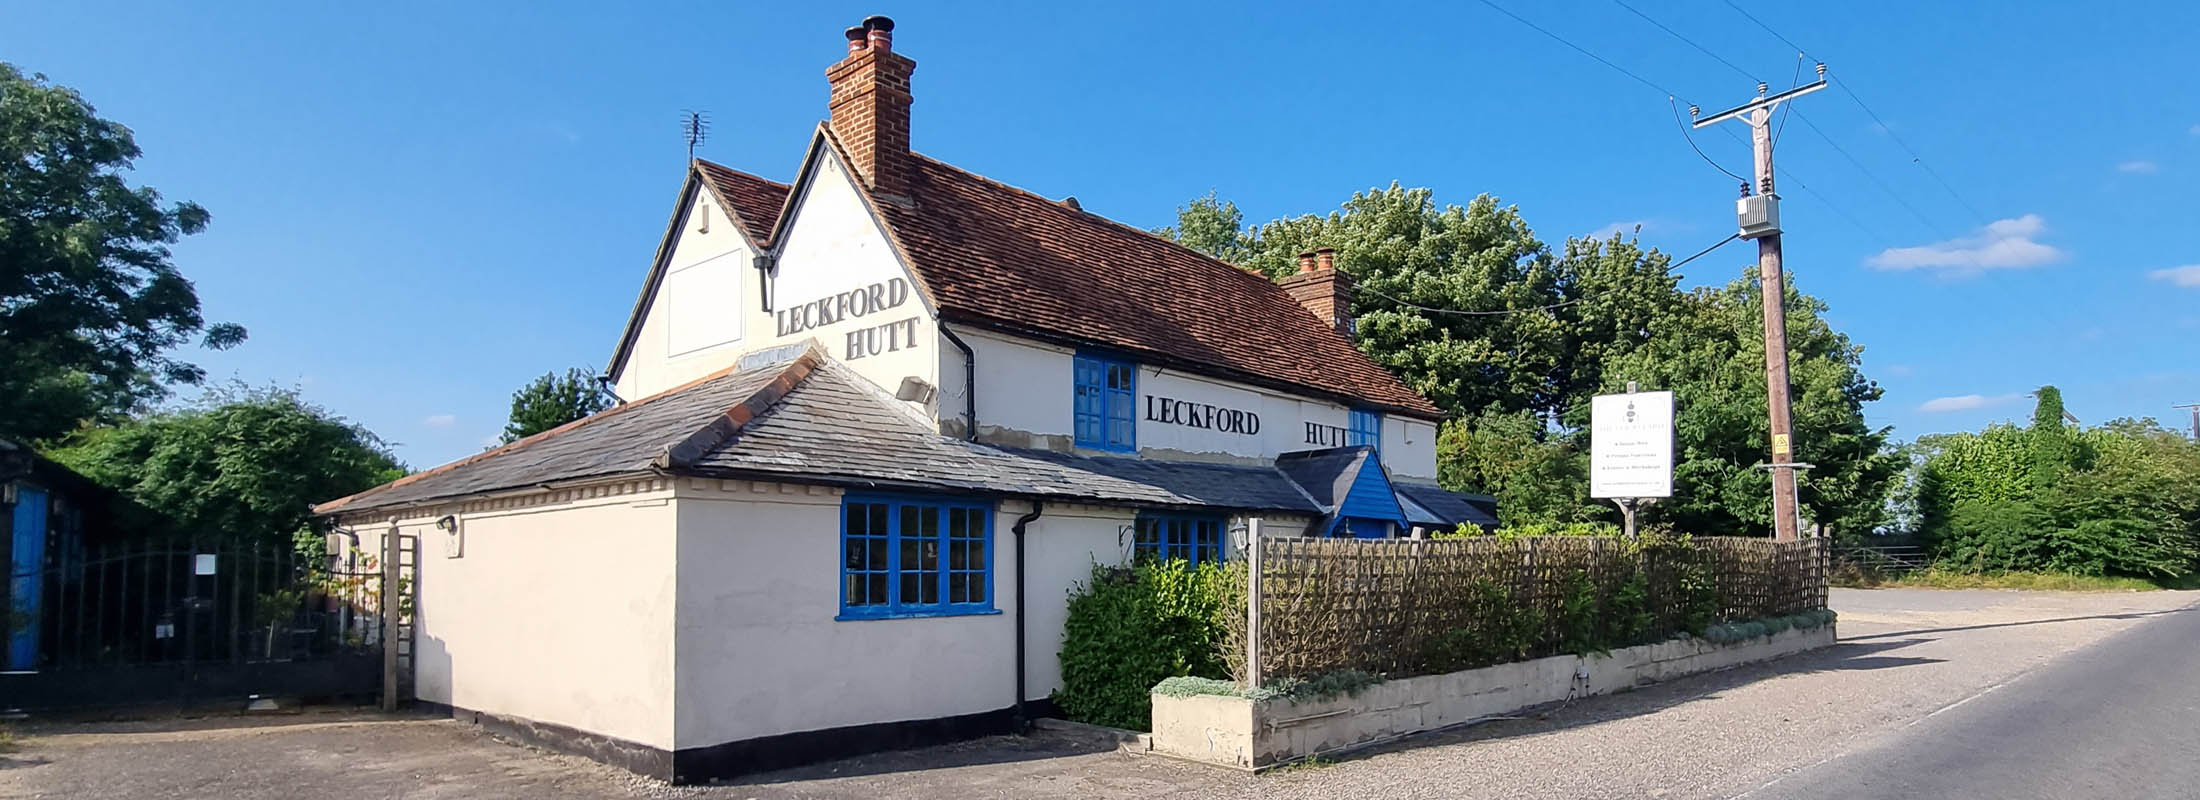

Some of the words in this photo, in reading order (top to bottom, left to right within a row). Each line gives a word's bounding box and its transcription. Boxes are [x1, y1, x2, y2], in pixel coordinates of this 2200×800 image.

[777, 277, 909, 338] LECKFORD
[845, 316, 921, 361] HUTT
[1145, 395, 1260, 436] LECKFORD
[1304, 421, 1348, 447] HUTT
